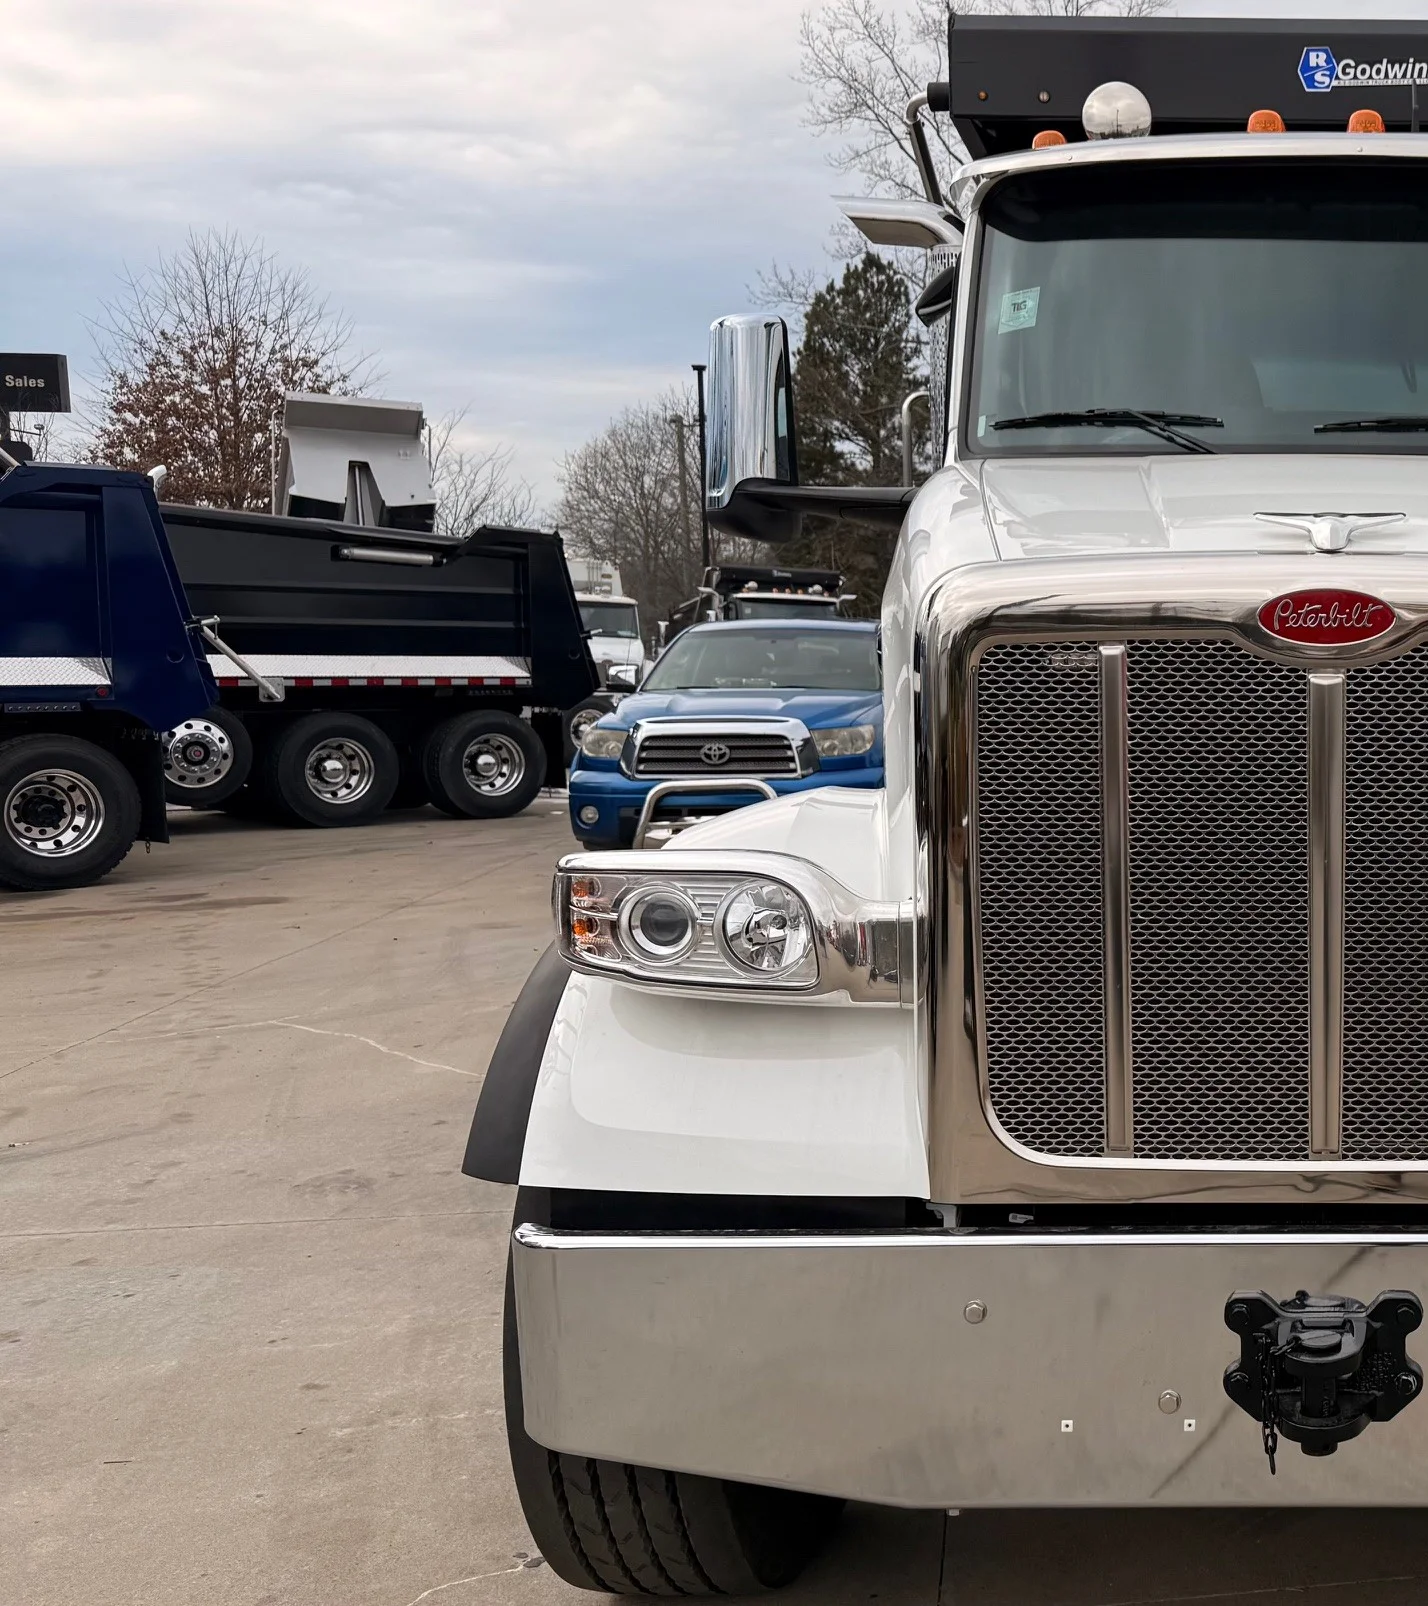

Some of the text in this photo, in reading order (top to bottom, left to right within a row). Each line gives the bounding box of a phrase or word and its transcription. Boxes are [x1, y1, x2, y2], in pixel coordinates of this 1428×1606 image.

[1309, 51, 1328, 67] R
[1337, 57, 1428, 80] Godwin
[1313, 70, 1331, 88] S
[5, 374, 45, 388] Sales
[1273, 599, 1383, 631] Peterbilt
